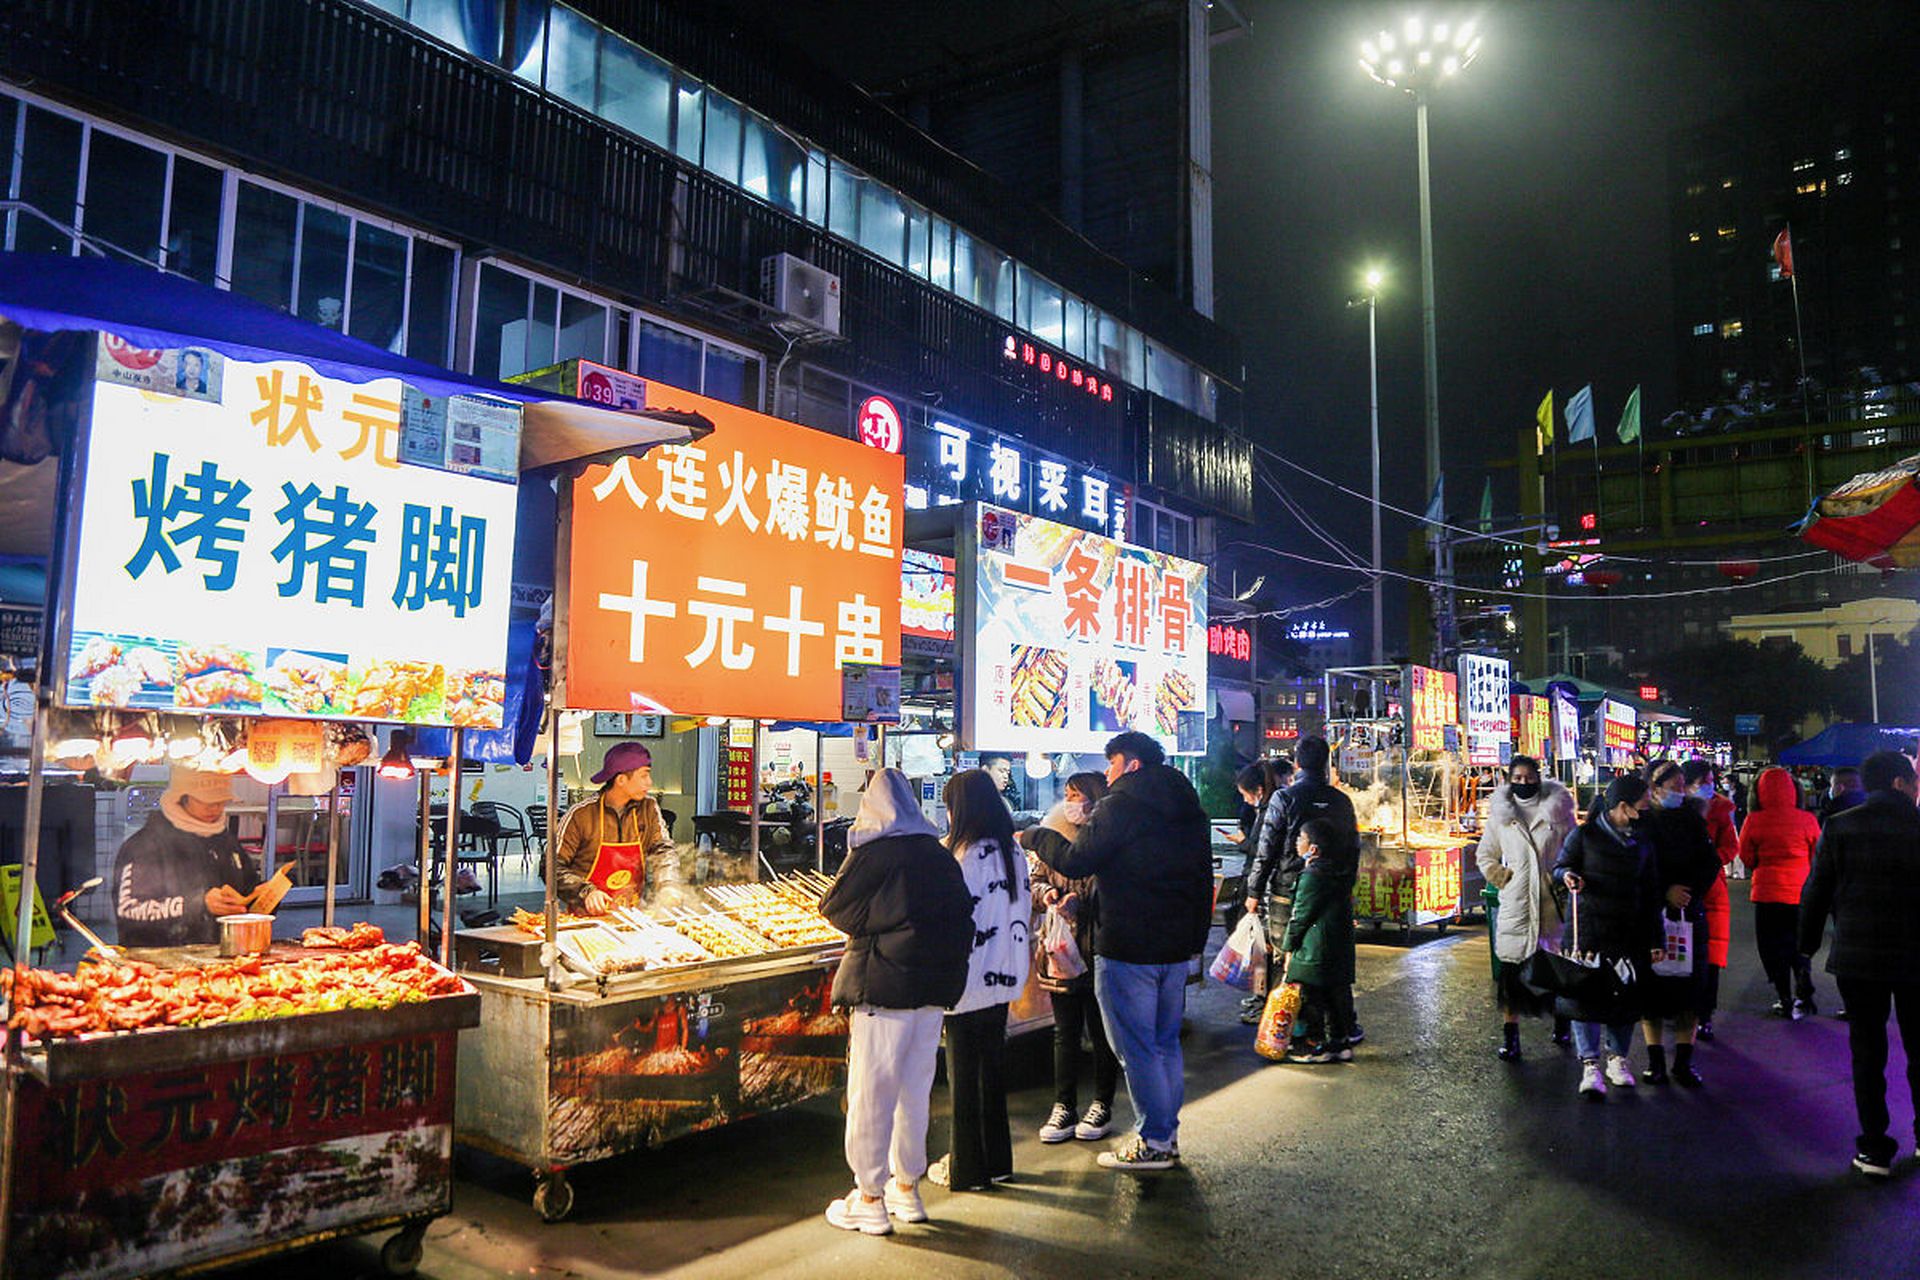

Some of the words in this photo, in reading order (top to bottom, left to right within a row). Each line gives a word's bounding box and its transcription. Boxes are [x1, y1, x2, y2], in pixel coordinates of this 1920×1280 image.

[251, 369, 402, 469] 状元
[583, 382, 612, 404] 039
[934, 421, 1110, 526] 可视采耳
[124, 452, 488, 619] 烤猪脚
[598, 559, 884, 678] 十元十串
[1003, 546, 1193, 652] 一条排骨
[51, 1039, 438, 1169] 状元烤猪脚
